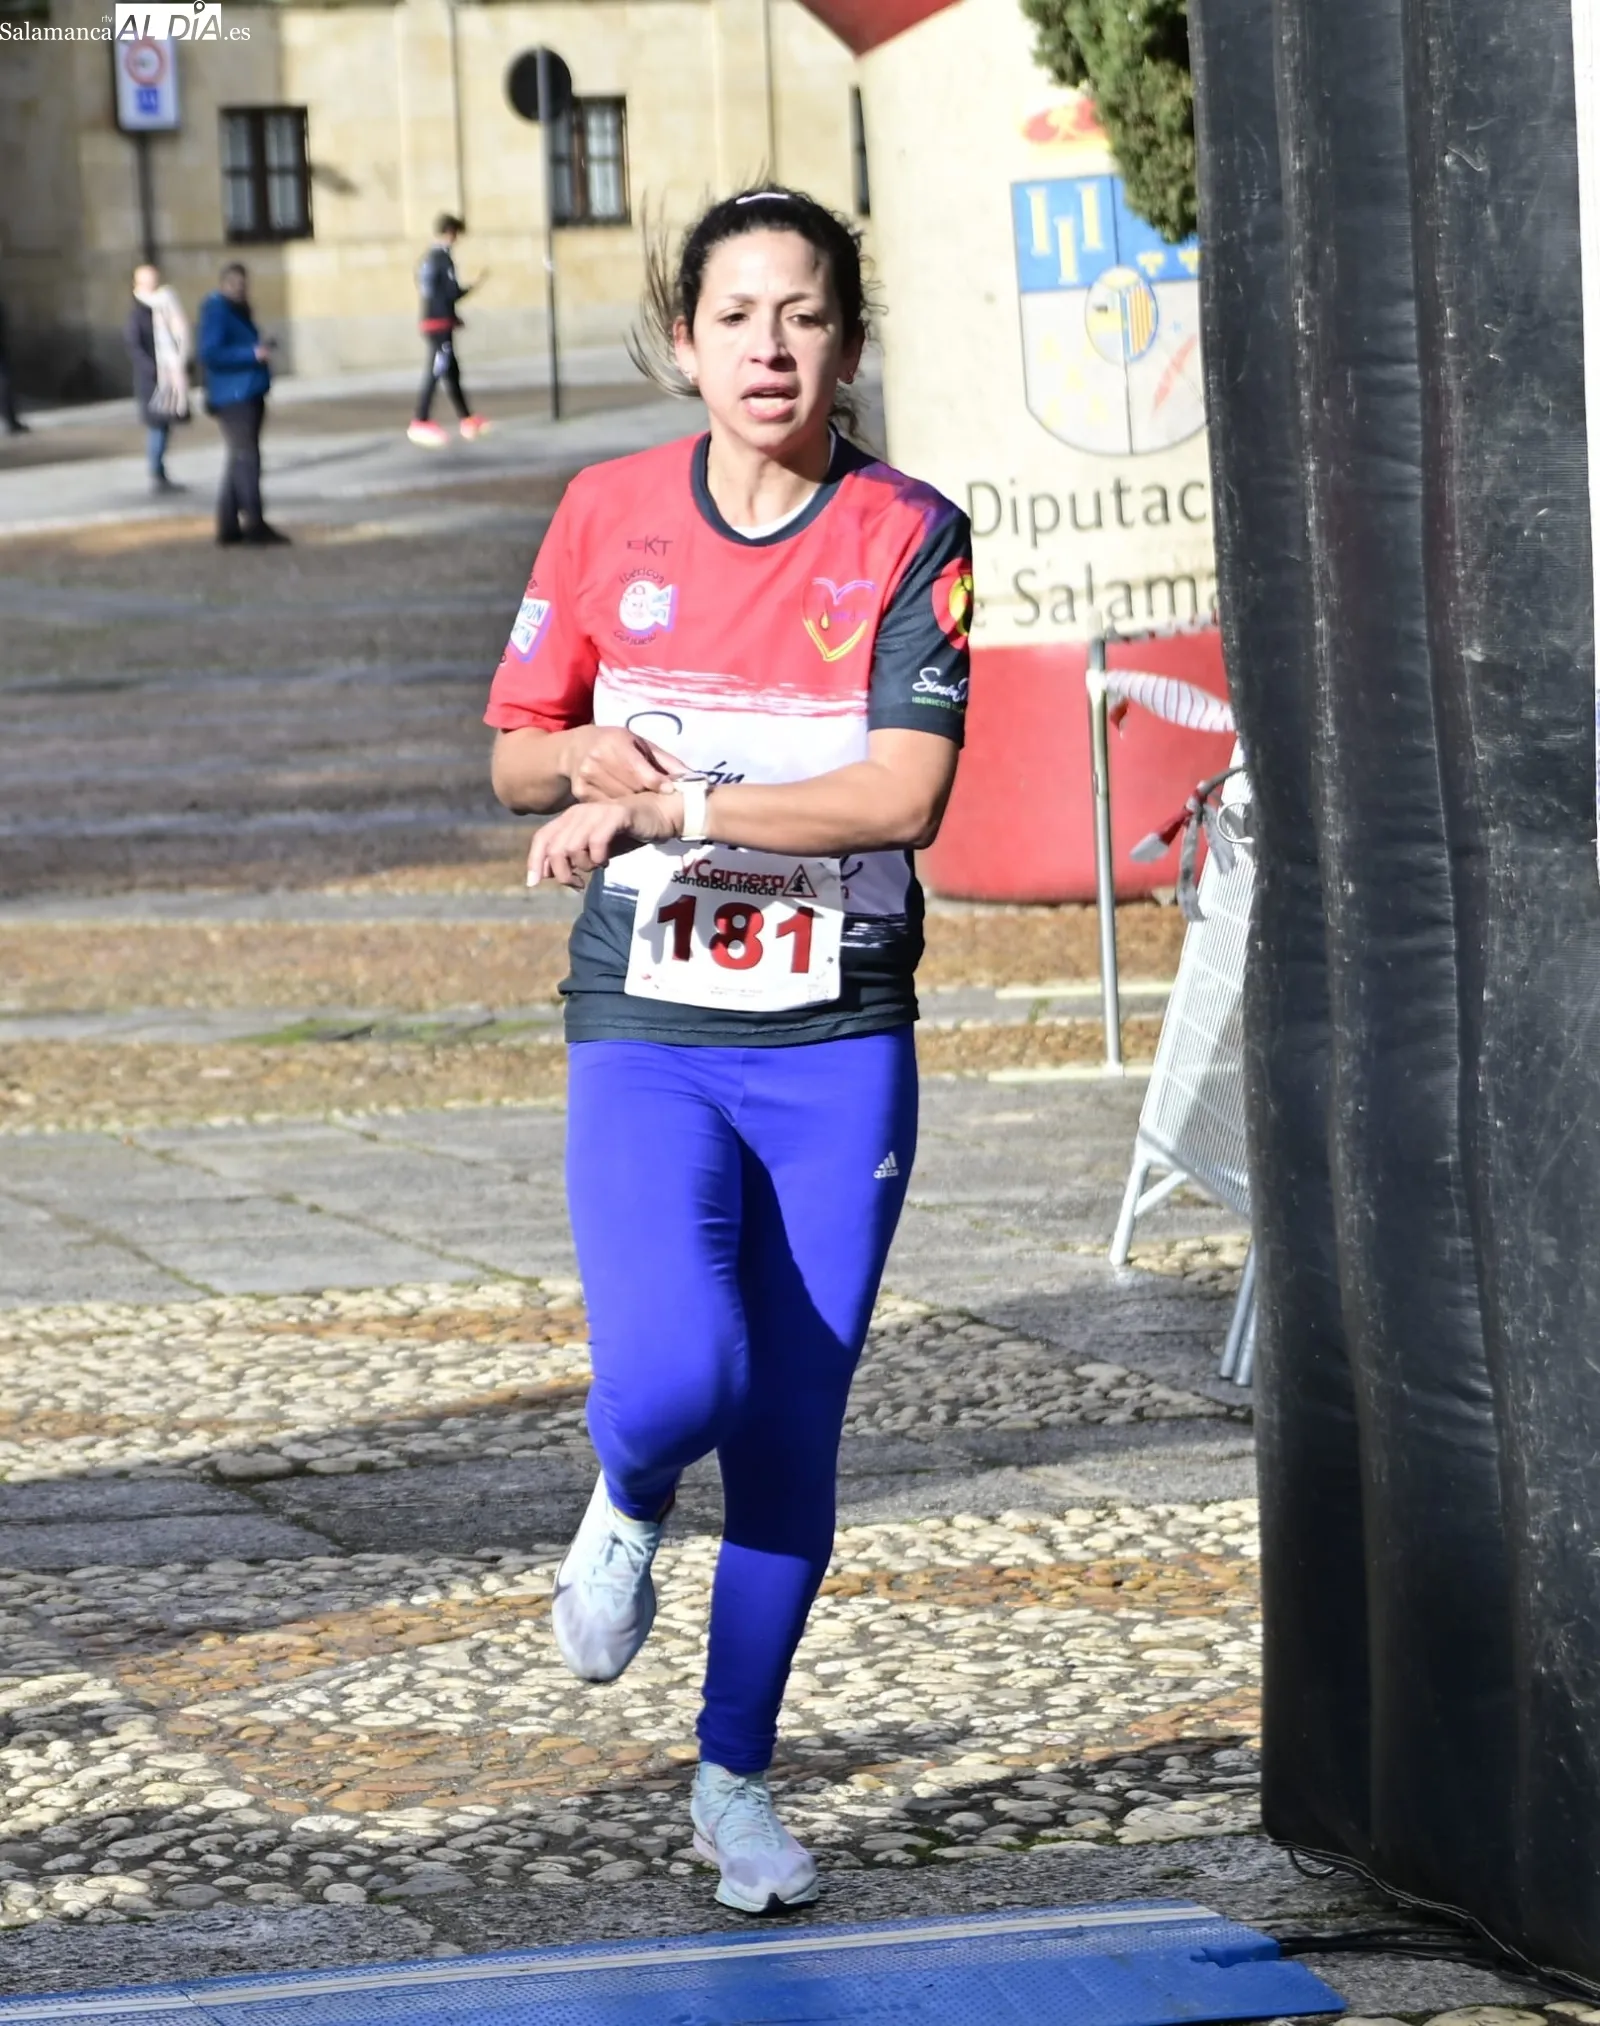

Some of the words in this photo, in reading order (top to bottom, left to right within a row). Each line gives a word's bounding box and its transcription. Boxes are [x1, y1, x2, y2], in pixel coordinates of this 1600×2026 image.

[966, 477, 1207, 549] Diputac
[694, 858, 785, 888] Carrera
[656, 893, 814, 974] 181
